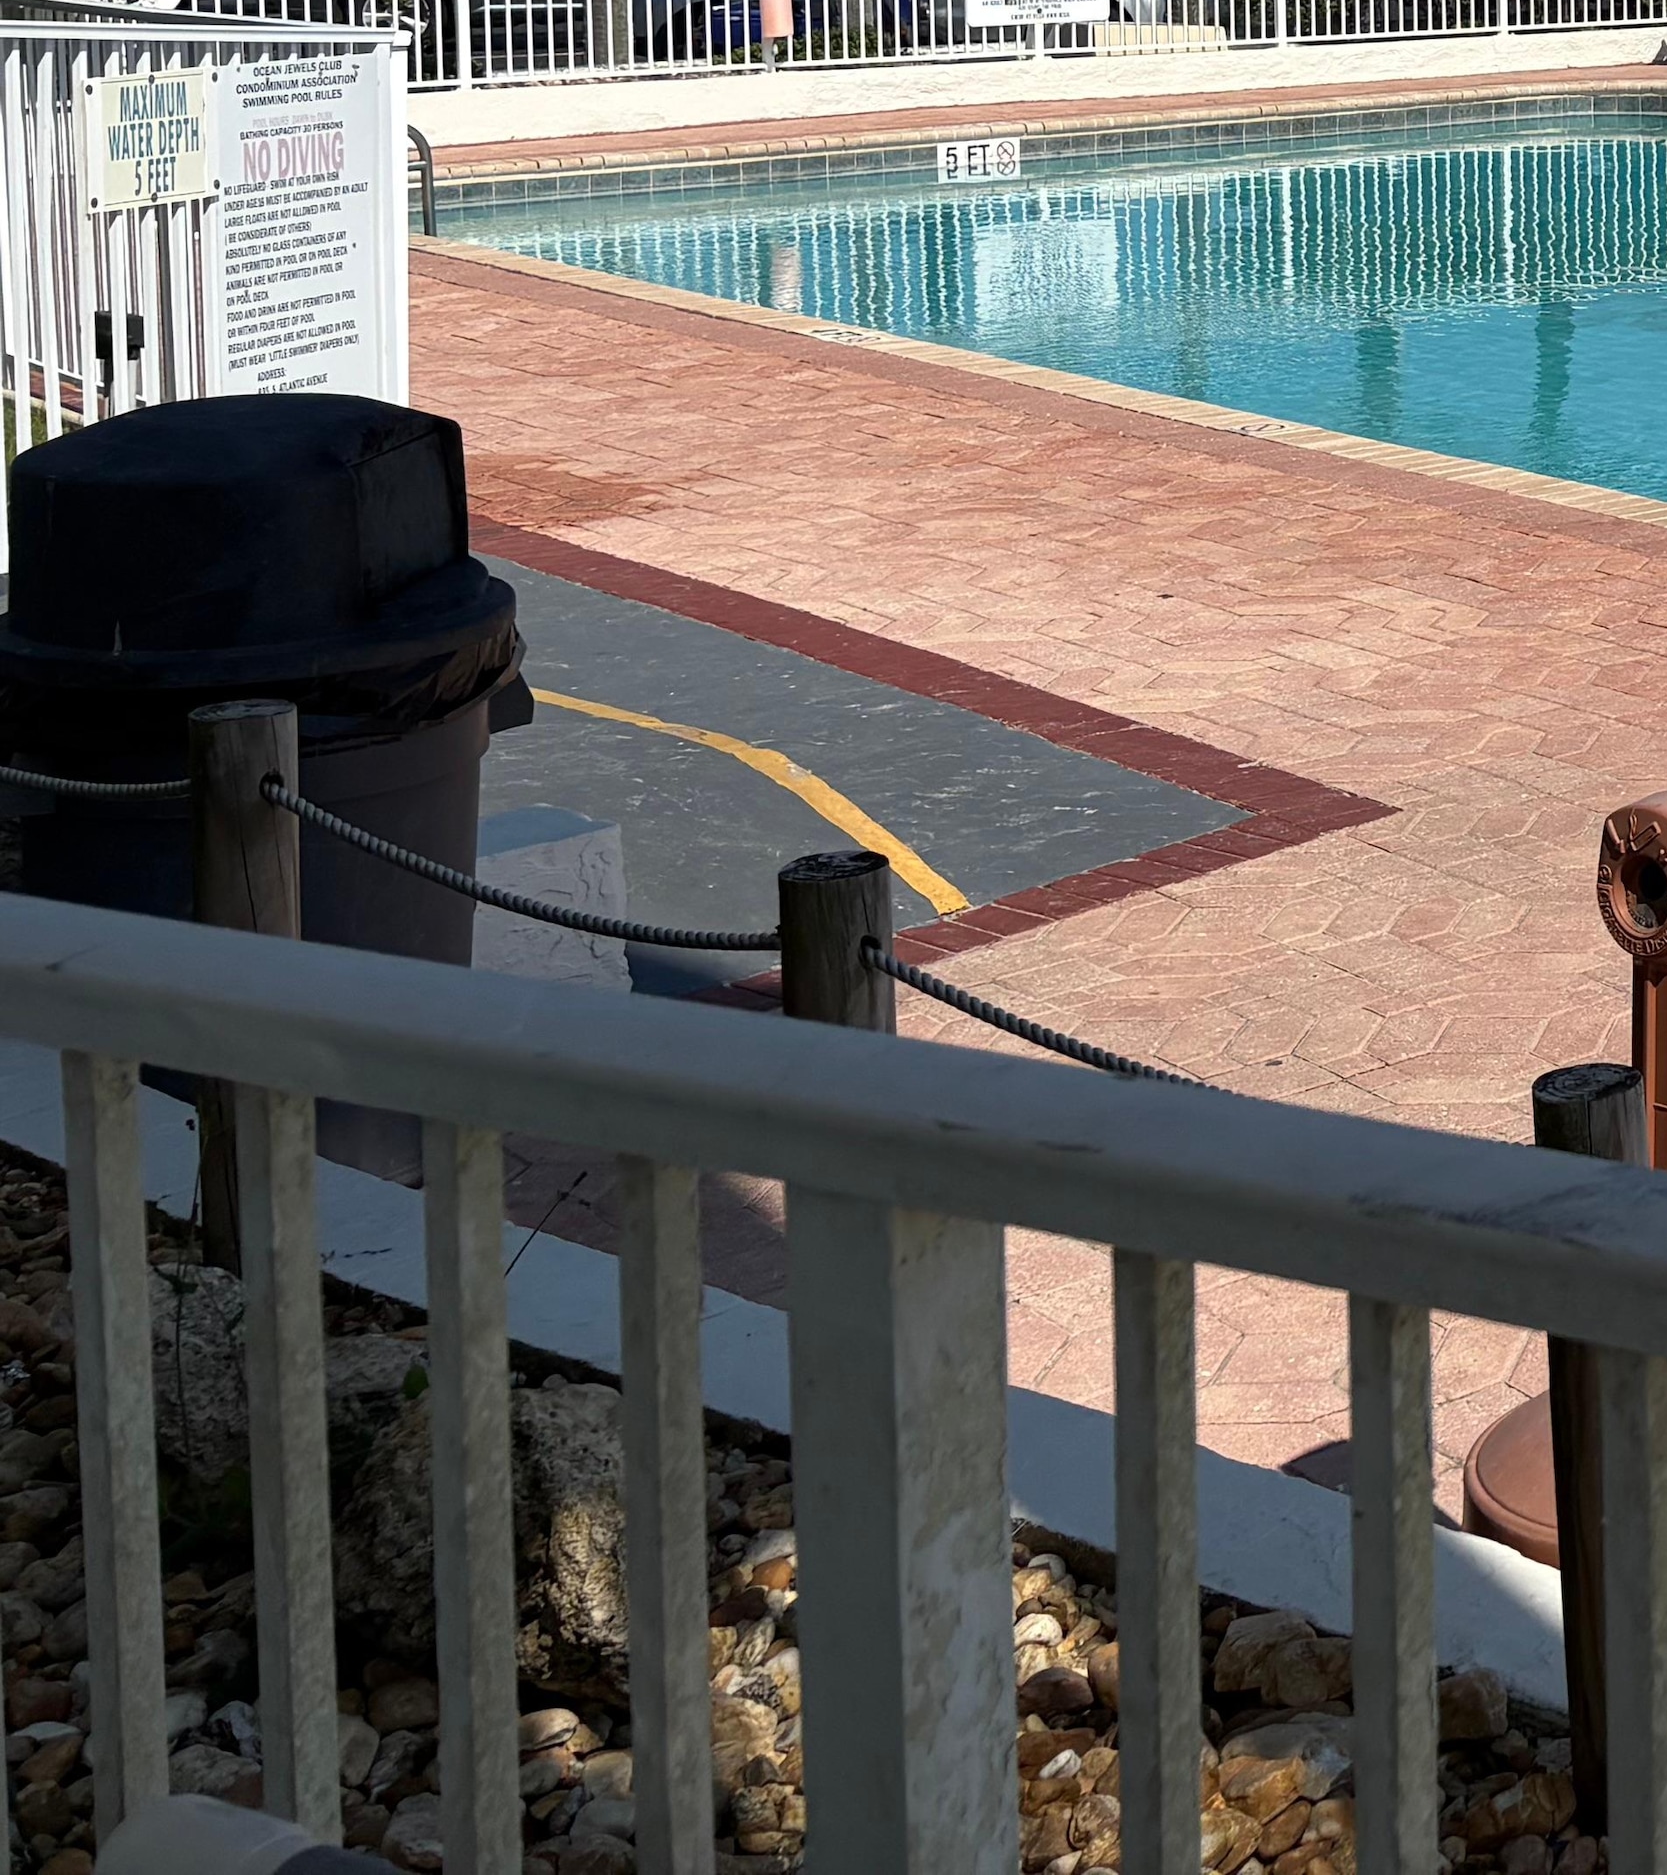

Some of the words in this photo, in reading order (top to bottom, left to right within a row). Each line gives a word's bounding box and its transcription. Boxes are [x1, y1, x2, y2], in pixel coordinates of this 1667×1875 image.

[253, 65, 282, 77] OCEAN
[284, 62, 316, 75] JEWELS
[318, 60, 342, 72] CLUB
[236, 80, 299, 95] CONDOMINIUM
[301, 74, 357, 88] ASSOCIATION
[120, 81, 188, 123] MAXIMUM
[242, 94, 289, 109] SWIMMING
[291, 92, 313, 104] POOL
[315, 89, 343, 101] RULES
[108, 121, 153, 161] WATER
[158, 117, 199, 156] DEPTH
[240, 129, 269, 141] BATHING
[270, 125, 301, 137] CAPACITY
[313, 120, 344, 132] PERSONS
[243, 140, 271, 183] NO
[277, 131, 344, 178] DIVING
[946, 146, 958, 165] 5
[134, 160, 142, 196] 5
[148, 156, 176, 194] FEET
[224, 186, 232, 195] NO
[270, 178, 287, 189] SWIM
[288, 176, 295, 186] AT
[296, 175, 311, 185] YOUR
[312, 173, 325, 183] OWN
[327, 171, 339, 181] RISK
[224, 200, 244, 212] UNDER
[266, 194, 281, 205] MUST
[284, 193, 290, 203] BE
[293, 187, 332, 201] ACCOMPANIED
[334, 186, 340, 196] BY
[342, 185, 349, 194] AN
[351, 182, 368, 192] ADULT
[224, 215, 244, 228] LARGE
[245, 212, 266, 224] FLOATS
[268, 210, 279, 221] ARE
[280, 208, 291, 219] NOT
[292, 204, 318, 217] ALLOWED
[319, 203, 325, 213] IN
[327, 201, 342, 212] POOL
[225, 245, 261, 260] ABSOLUTELY
[263, 243, 270, 252] NO
[273, 239, 290, 252] GLASS
[292, 233, 326, 248] CONTAINERS
[327, 231, 335, 242] OF
[336, 230, 346, 240] ANY
[238, 227, 277, 242] CONSIDERATE
[279, 224, 286, 235] OF
[225, 264, 240, 275] KIND
[241, 258, 274, 272] PERMITTED
[276, 256, 281, 266] IN
[283, 254, 298, 265] POOL
[299, 252, 307, 262] OR
[308, 251, 316, 261] ON
[317, 248, 332, 259] POOL
[333, 245, 348, 257] DECK
[226, 276, 253, 291] ANIMALS
[254, 274, 266, 286] ARE
[267, 272, 279, 283] NOT
[279, 267, 311, 281] PERMITTED
[312, 266, 318, 276] IN
[319, 263, 334, 274] POOL
[335, 261, 343, 272] OR
[226, 296, 235, 307] ON
[236, 294, 252, 305] POOL
[252, 290, 269, 302] DECK
[226, 310, 243, 323] FOOD
[244, 308, 257, 319] AND
[257, 305, 276, 317] DRINK
[277, 301, 289, 312] ARE
[290, 299, 301, 310] NOT
[302, 293, 334, 308] PERMITTED
[334, 292, 341, 302] IN
[341, 289, 356, 301] POOL
[227, 328, 236, 339] OR
[236, 324, 258, 336] WITHIN
[259, 320, 276, 332] FOUR
[276, 316, 290, 329] FEET
[291, 315, 299, 326] OF
[300, 312, 315, 324] POOL
[227, 339, 256, 354] REGULAR
[256, 334, 282, 348] DIAPERS
[283, 331, 294, 342] ARE
[296, 329, 307, 340] NOT
[308, 323, 334, 337] ALLOWED
[334, 322, 341, 333] IN
[341, 319, 356, 331] POOL
[248, 353, 266, 365] WEAR
[319, 336, 343, 351] DIAPERS
[279, 378, 305, 392] ATLANTIC
[306, 372, 328, 386] AVENUE
